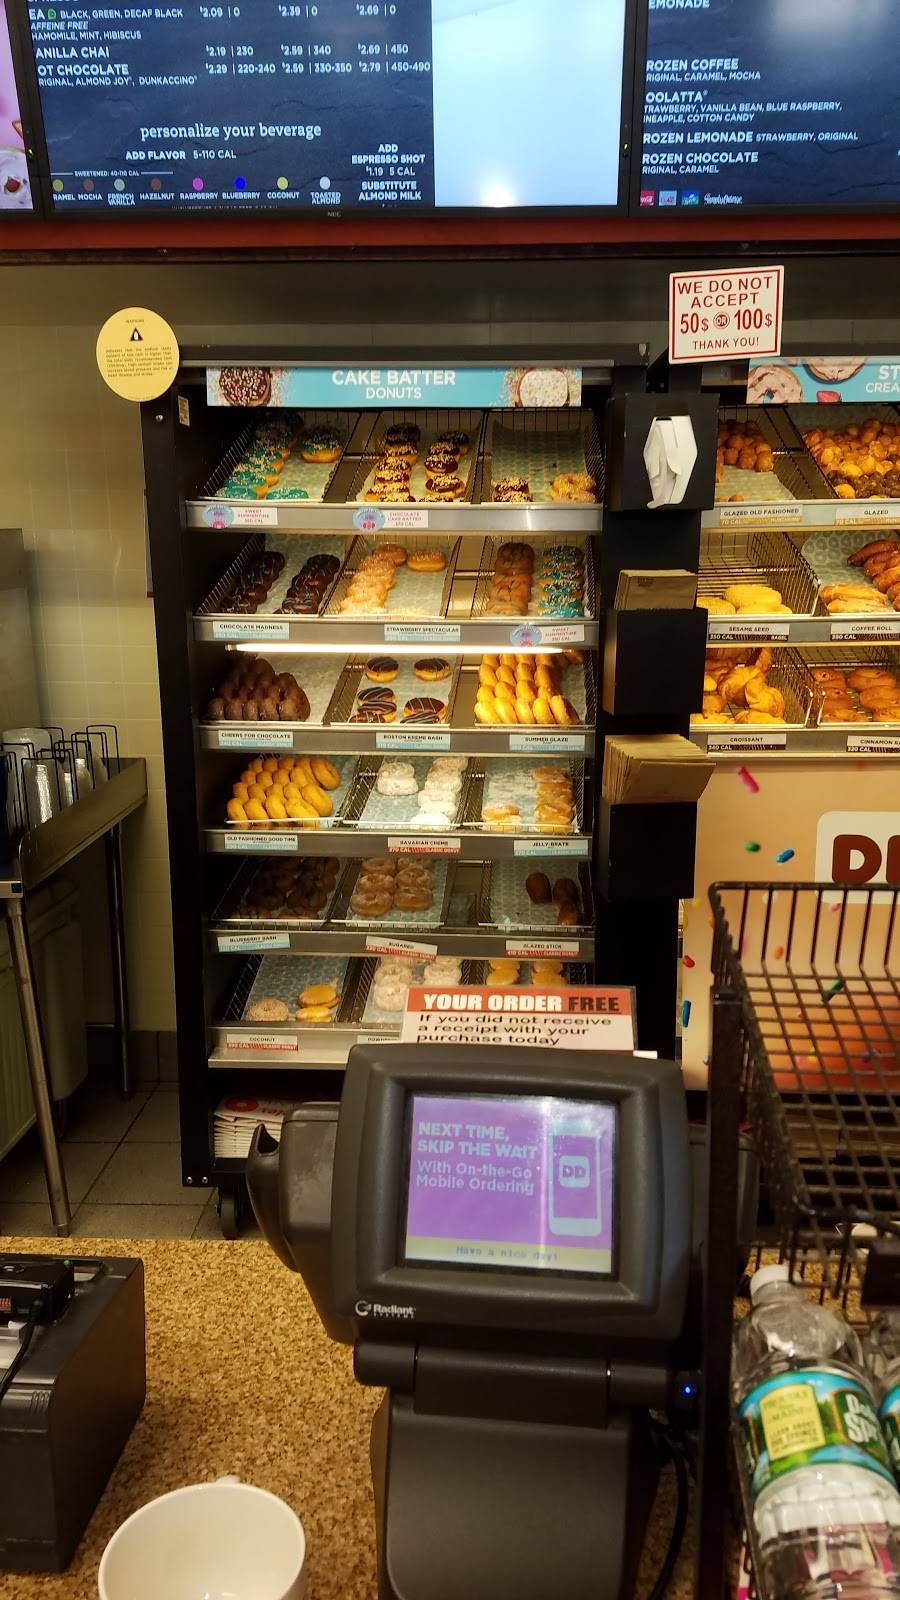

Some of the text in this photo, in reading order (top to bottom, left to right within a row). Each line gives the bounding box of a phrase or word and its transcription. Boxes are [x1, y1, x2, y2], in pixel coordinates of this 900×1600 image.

[60, 11, 89, 19] BLACK,
[155, 9, 183, 17] BLACK
[67, 21, 89, 30] FREE
[80, 32, 101, 41] MINT,
[104, 31, 141, 39] HIBISCUS
[36, 47, 109, 58] ANILLA CHAI
[38, 64, 129, 75] OT CHOCOLATE
[647, 58, 738, 71] ROZEN COFFEE
[684, 72, 727, 81] CARAMEL,
[729, 71, 760, 80] MOCHA
[76, 78, 111, 86] ALMOND
[701, 104, 737, 112] VANILLA
[739, 103, 764, 112] BEAN,
[766, 103, 788, 111] BLUE
[790, 102, 842, 111] RASPBERRY,
[687, 114, 723, 123] COTTON
[725, 113, 754, 122] CANDY
[140, 123, 321, 141] personalize your beverage
[643, 132, 858, 144] ROZEN LEMONADE STRAWBERRY, ORIGINAL
[378, 144, 398, 153] ADD
[126, 152, 145, 160] ADD
[148, 152, 186, 160] FLAVOR
[217, 150, 237, 159] CAL
[352, 154, 425, 164] ESPRESSO SHOT
[642, 152, 758, 164] ROZEN CHOCOLATE
[389, 167, 415, 175] 5 CAL
[679, 165, 719, 174] CARAMEL
[362, 181, 416, 190] SUBSTITUTE
[140, 192, 174, 200] HAZELNUT
[359, 192, 421, 200] ALMOND MILK
[678, 276, 772, 294] WE DO NOT
[691, 292, 759, 309] ACCEPT
[680, 312, 709, 334] 50$
[734, 308, 772, 330] 100$
[693, 337, 759, 350] THANK YOU!
[332, 371, 456, 386] CAKE BATTER
[365, 387, 422, 399] DONUTS
[424, 994, 620, 1012] YOUR ORDER FREE
[420, 1014, 431, 1022] If
[439, 1016, 469, 1025] you
[476, 1014, 503, 1023] did
[510, 1016, 539, 1024] not
[434, 1025, 497, 1034] receipt
[504, 1025, 541, 1034] with
[417, 1034, 559, 1046] purchase today
[419, 1122, 510, 1142] NEXT TIME,
[418, 1140, 538, 1159] SKIP THE WAIT
[417, 1160, 532, 1179] With On-the-Go
[563, 1165, 587, 1179] DD
[416, 1175, 534, 1195] Mobile Ordering
[456, 1246, 482, 1255] Have
[374, 1304, 414, 1314] Radiant
